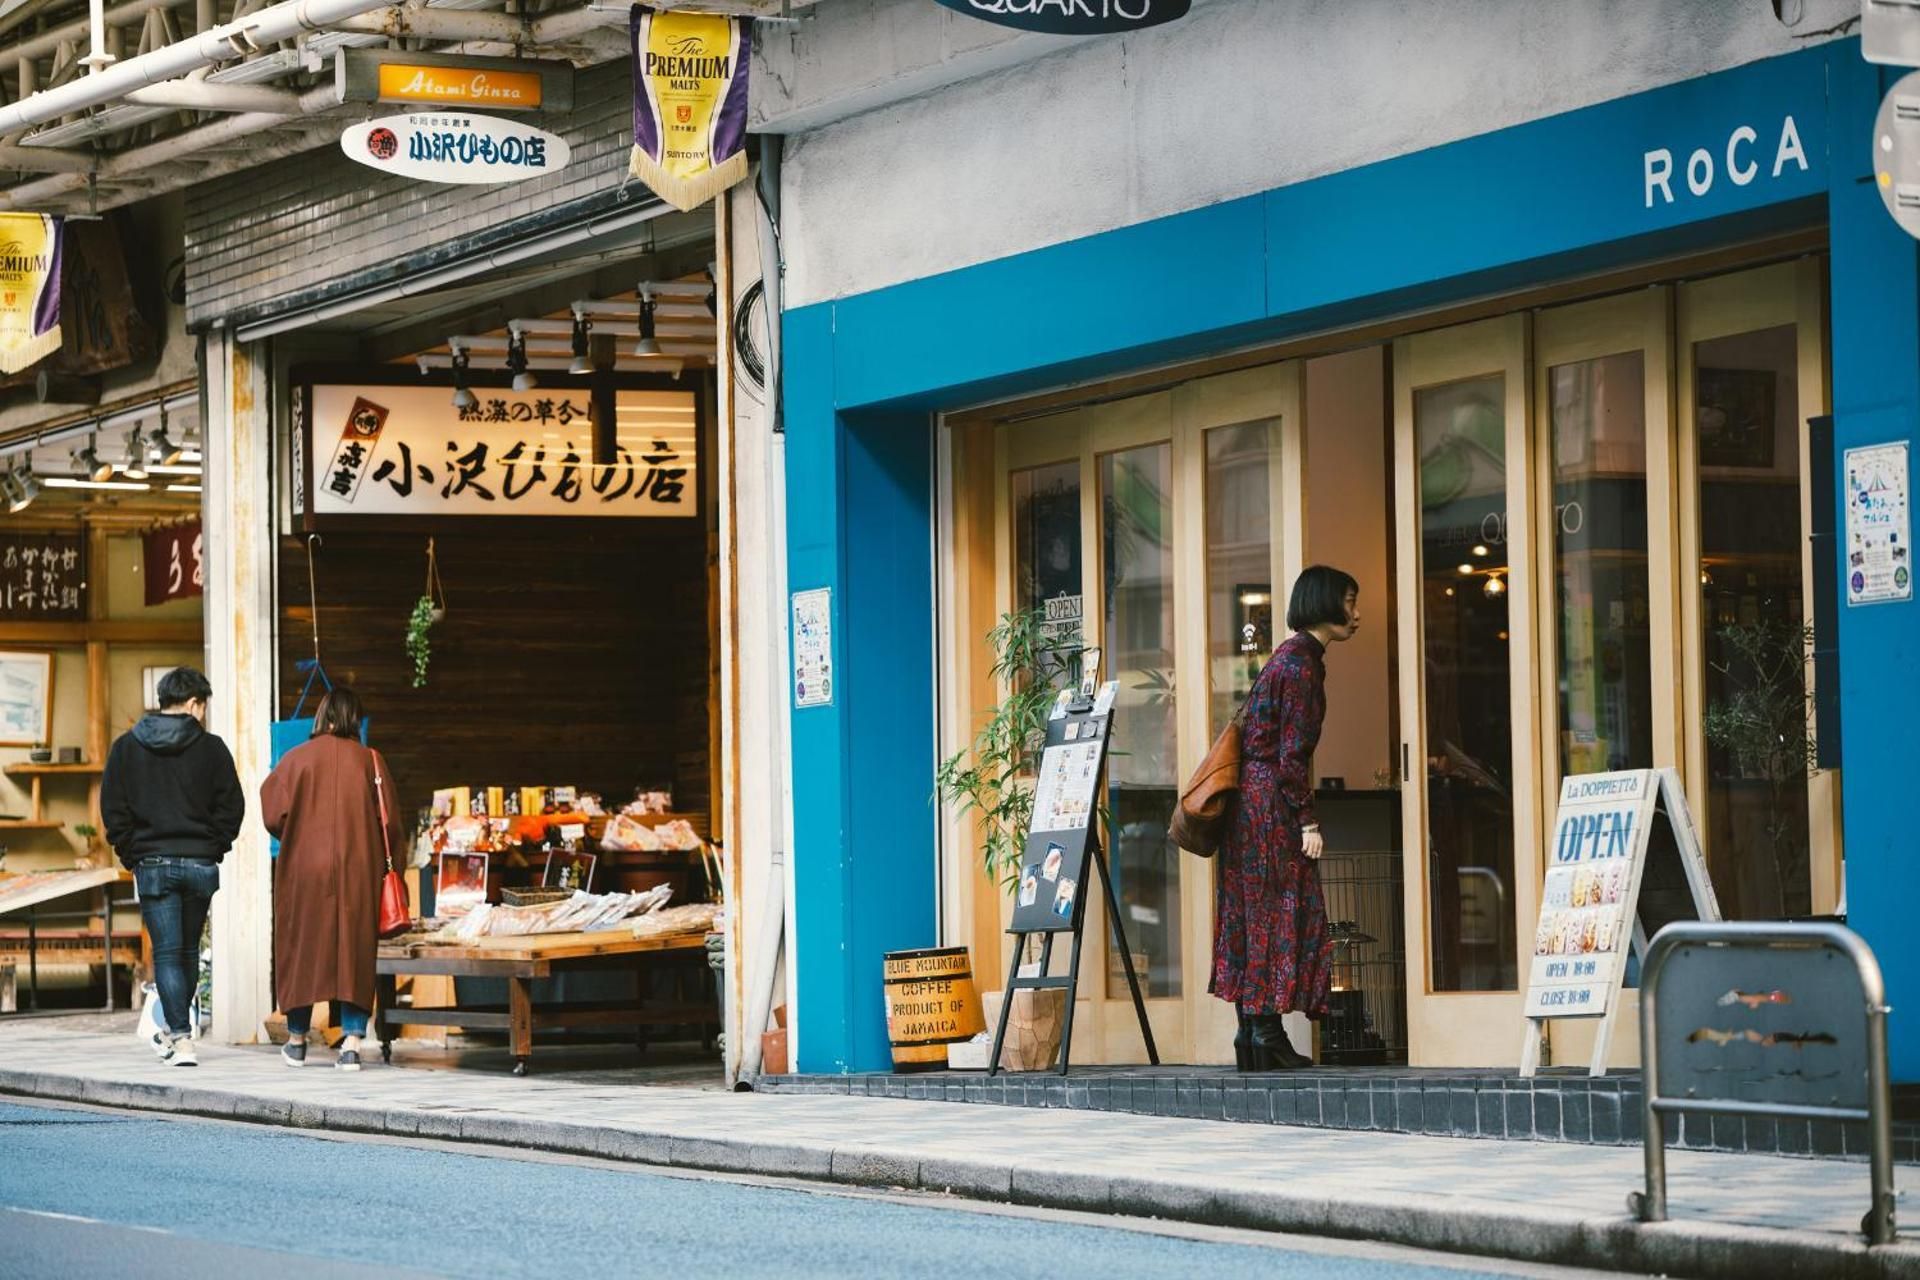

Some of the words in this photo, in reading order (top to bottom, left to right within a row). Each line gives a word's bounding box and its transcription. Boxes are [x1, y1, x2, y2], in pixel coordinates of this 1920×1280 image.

[645, 52, 730, 79] PREMIUM
[400, 71, 466, 96] Atami
[470, 74, 521, 98] Ginza
[410, 131, 546, 167] 小沢ひもの店
[667, 150, 705, 159] SUNTORY
[458, 399, 592, 425] 熱海の草分
[372, 438, 688, 503] 小沢ひもの店
[1049, 599, 1078, 619] OPEN
[1567, 784, 1578, 799] La
[1558, 811, 1633, 862] OPEN
[888, 959, 911, 974] BLUE
[916, 956, 967, 973] MOUNTAIN
[1546, 962, 1568, 977] OPEN
[901, 981, 953, 997] COFFEE
[1540, 991, 1567, 1006] CLOSE
[893, 1001, 944, 1016] PRODUCT
[950, 1000, 963, 1013] OF
[903, 1020, 957, 1036] JAMAICA
